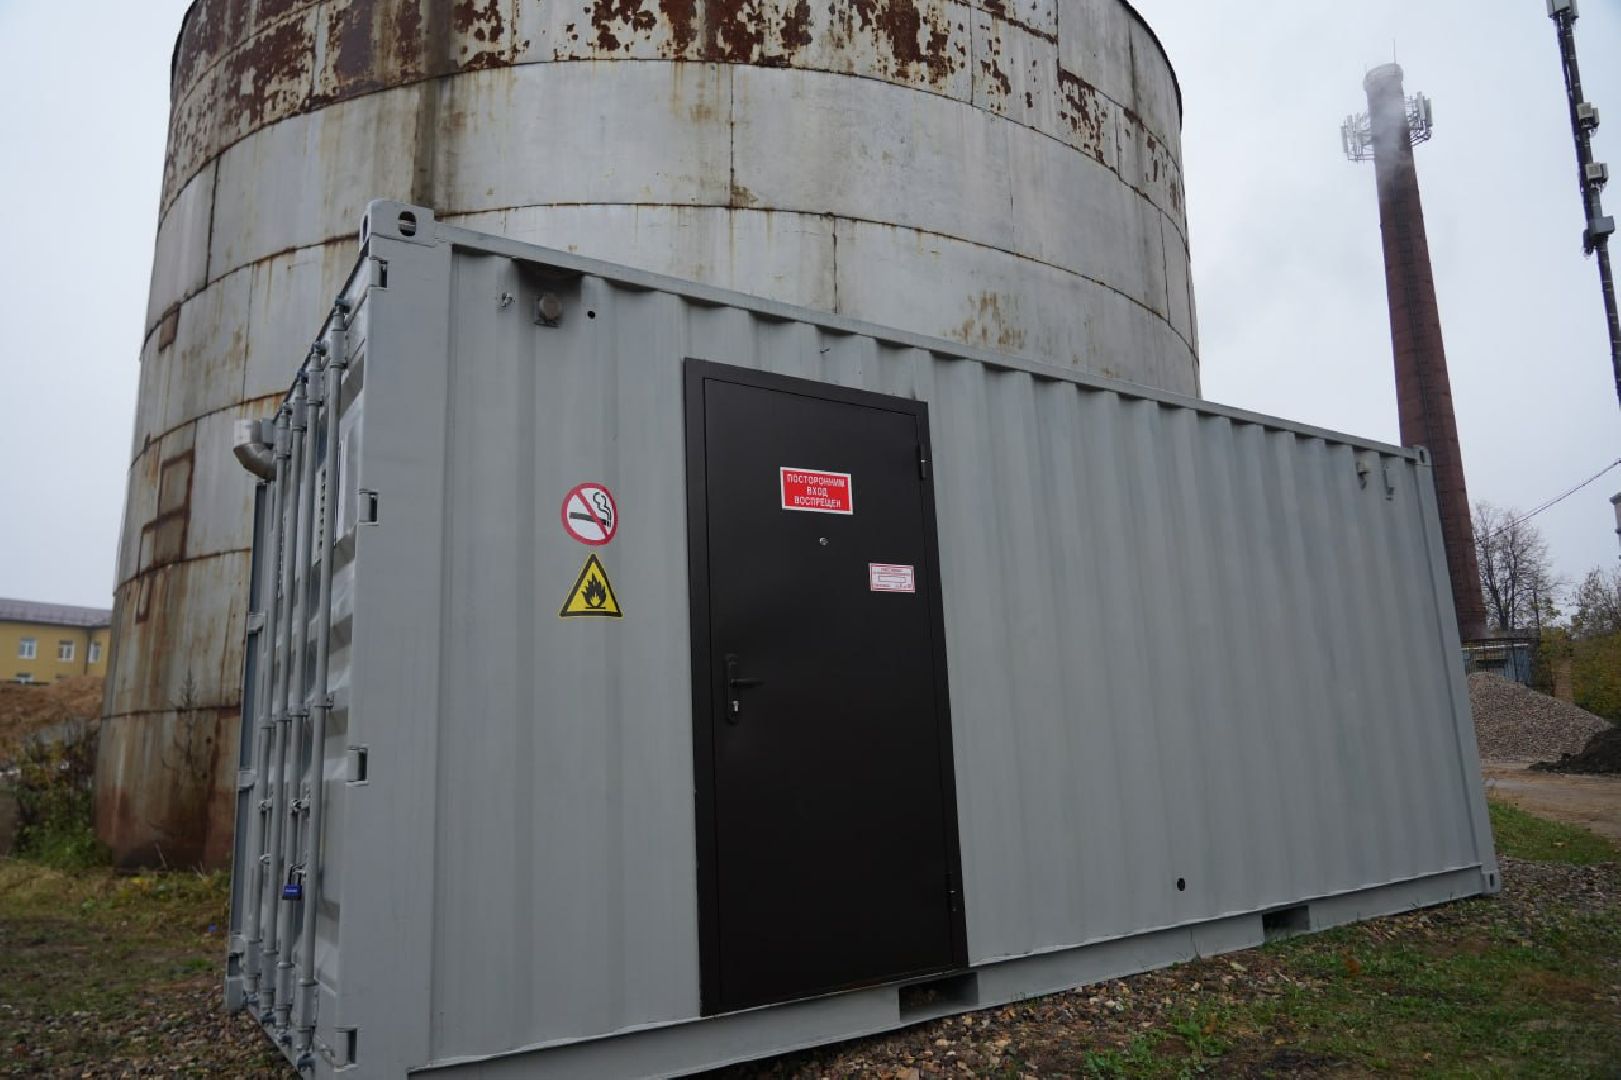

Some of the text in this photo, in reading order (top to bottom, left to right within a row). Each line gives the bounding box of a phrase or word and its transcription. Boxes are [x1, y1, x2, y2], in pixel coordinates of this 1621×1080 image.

[786, 473, 845, 488] ПОСТОРОННИМ
[806, 486, 828, 498] ВХОД
[794, 495, 841, 508] ВОСПРЕЩЕН
